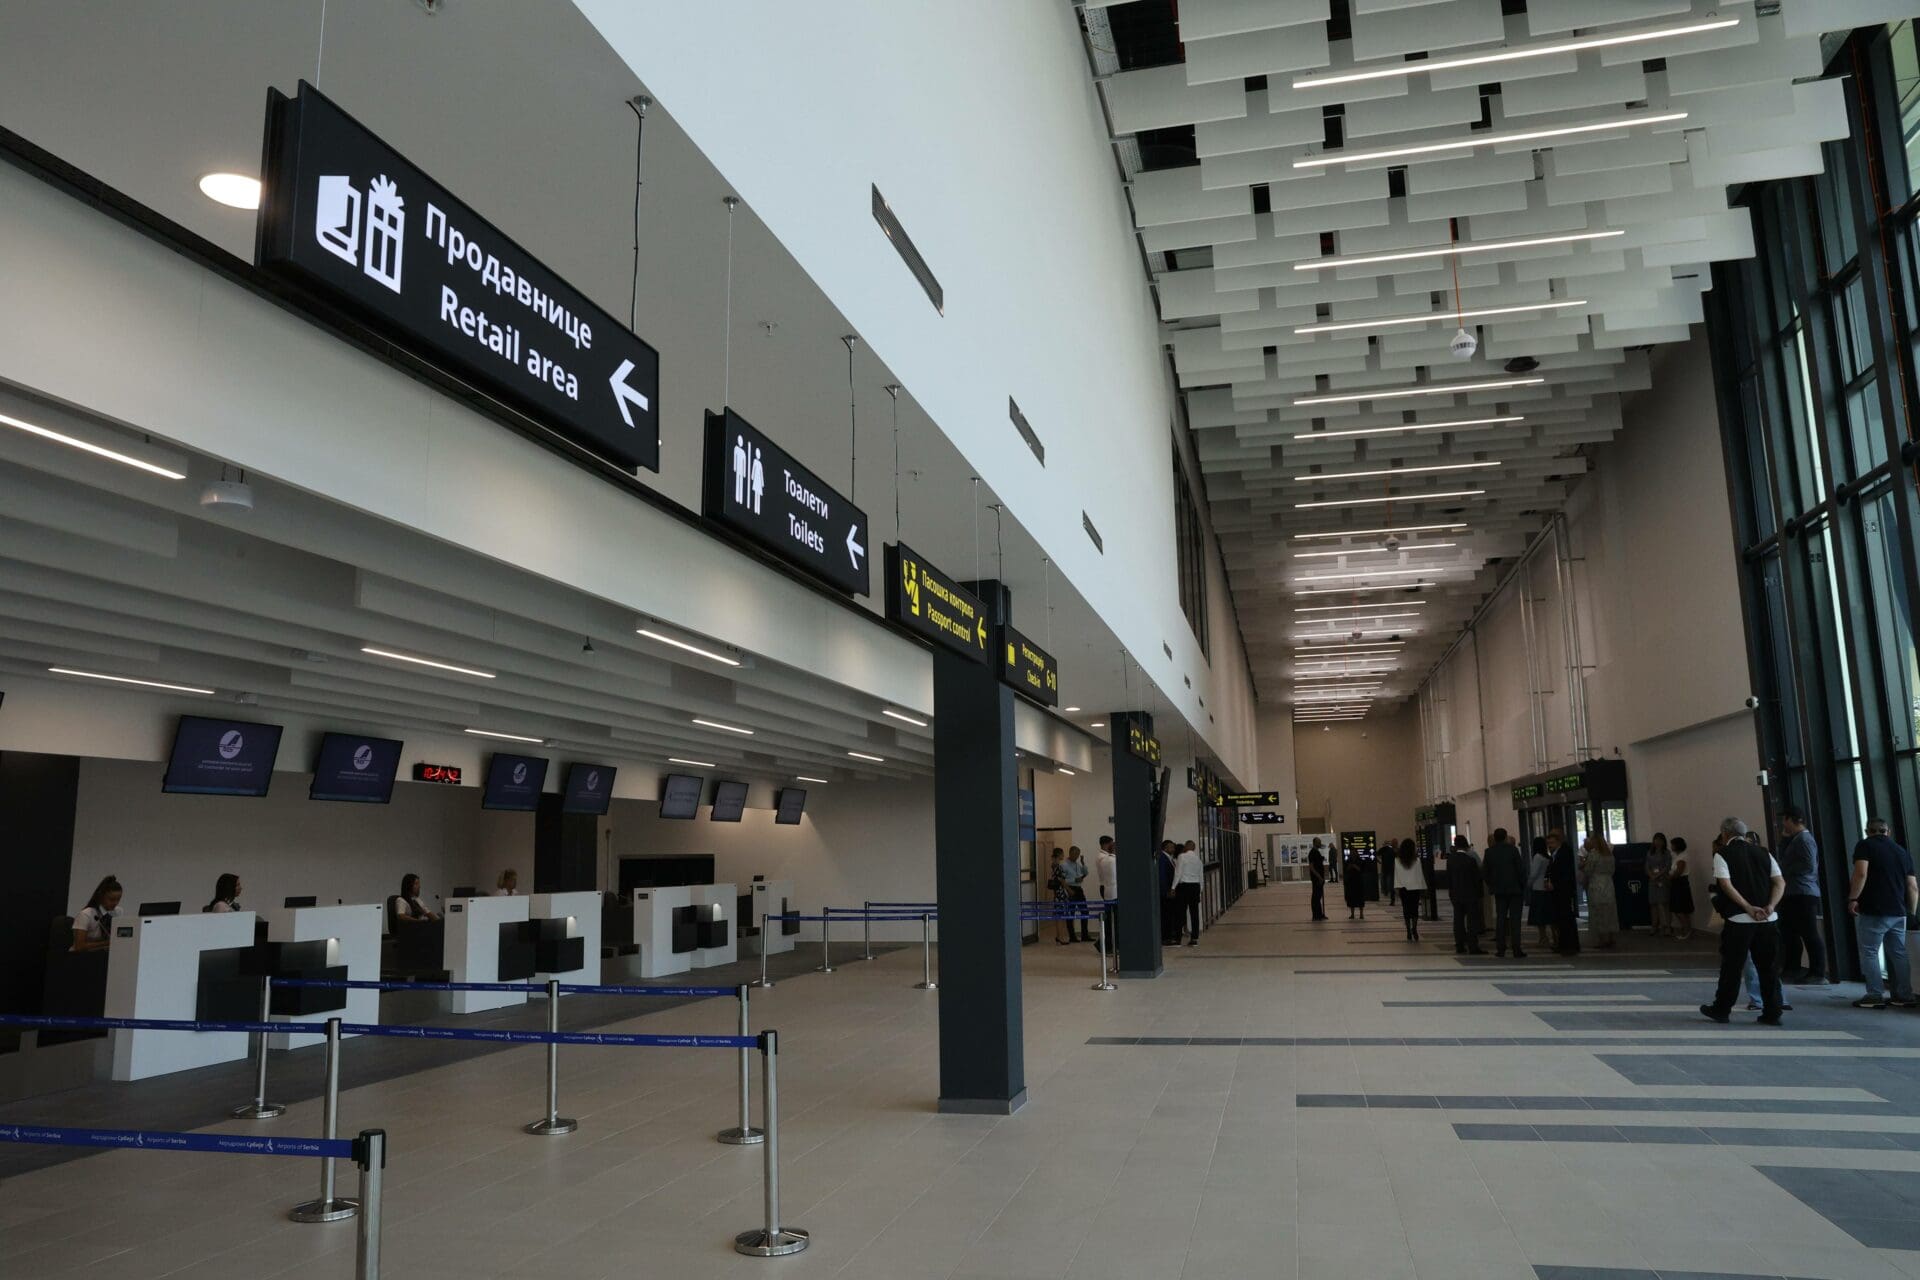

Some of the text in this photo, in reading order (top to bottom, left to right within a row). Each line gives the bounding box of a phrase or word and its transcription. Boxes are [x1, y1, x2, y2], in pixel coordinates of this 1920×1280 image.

[425, 202, 592, 349] Продавнице
[440, 284, 578, 401] Retail area
[783, 469, 829, 520] Тоалети
[788, 512, 824, 554] Toilets
[927, 602, 971, 643] Passport control
